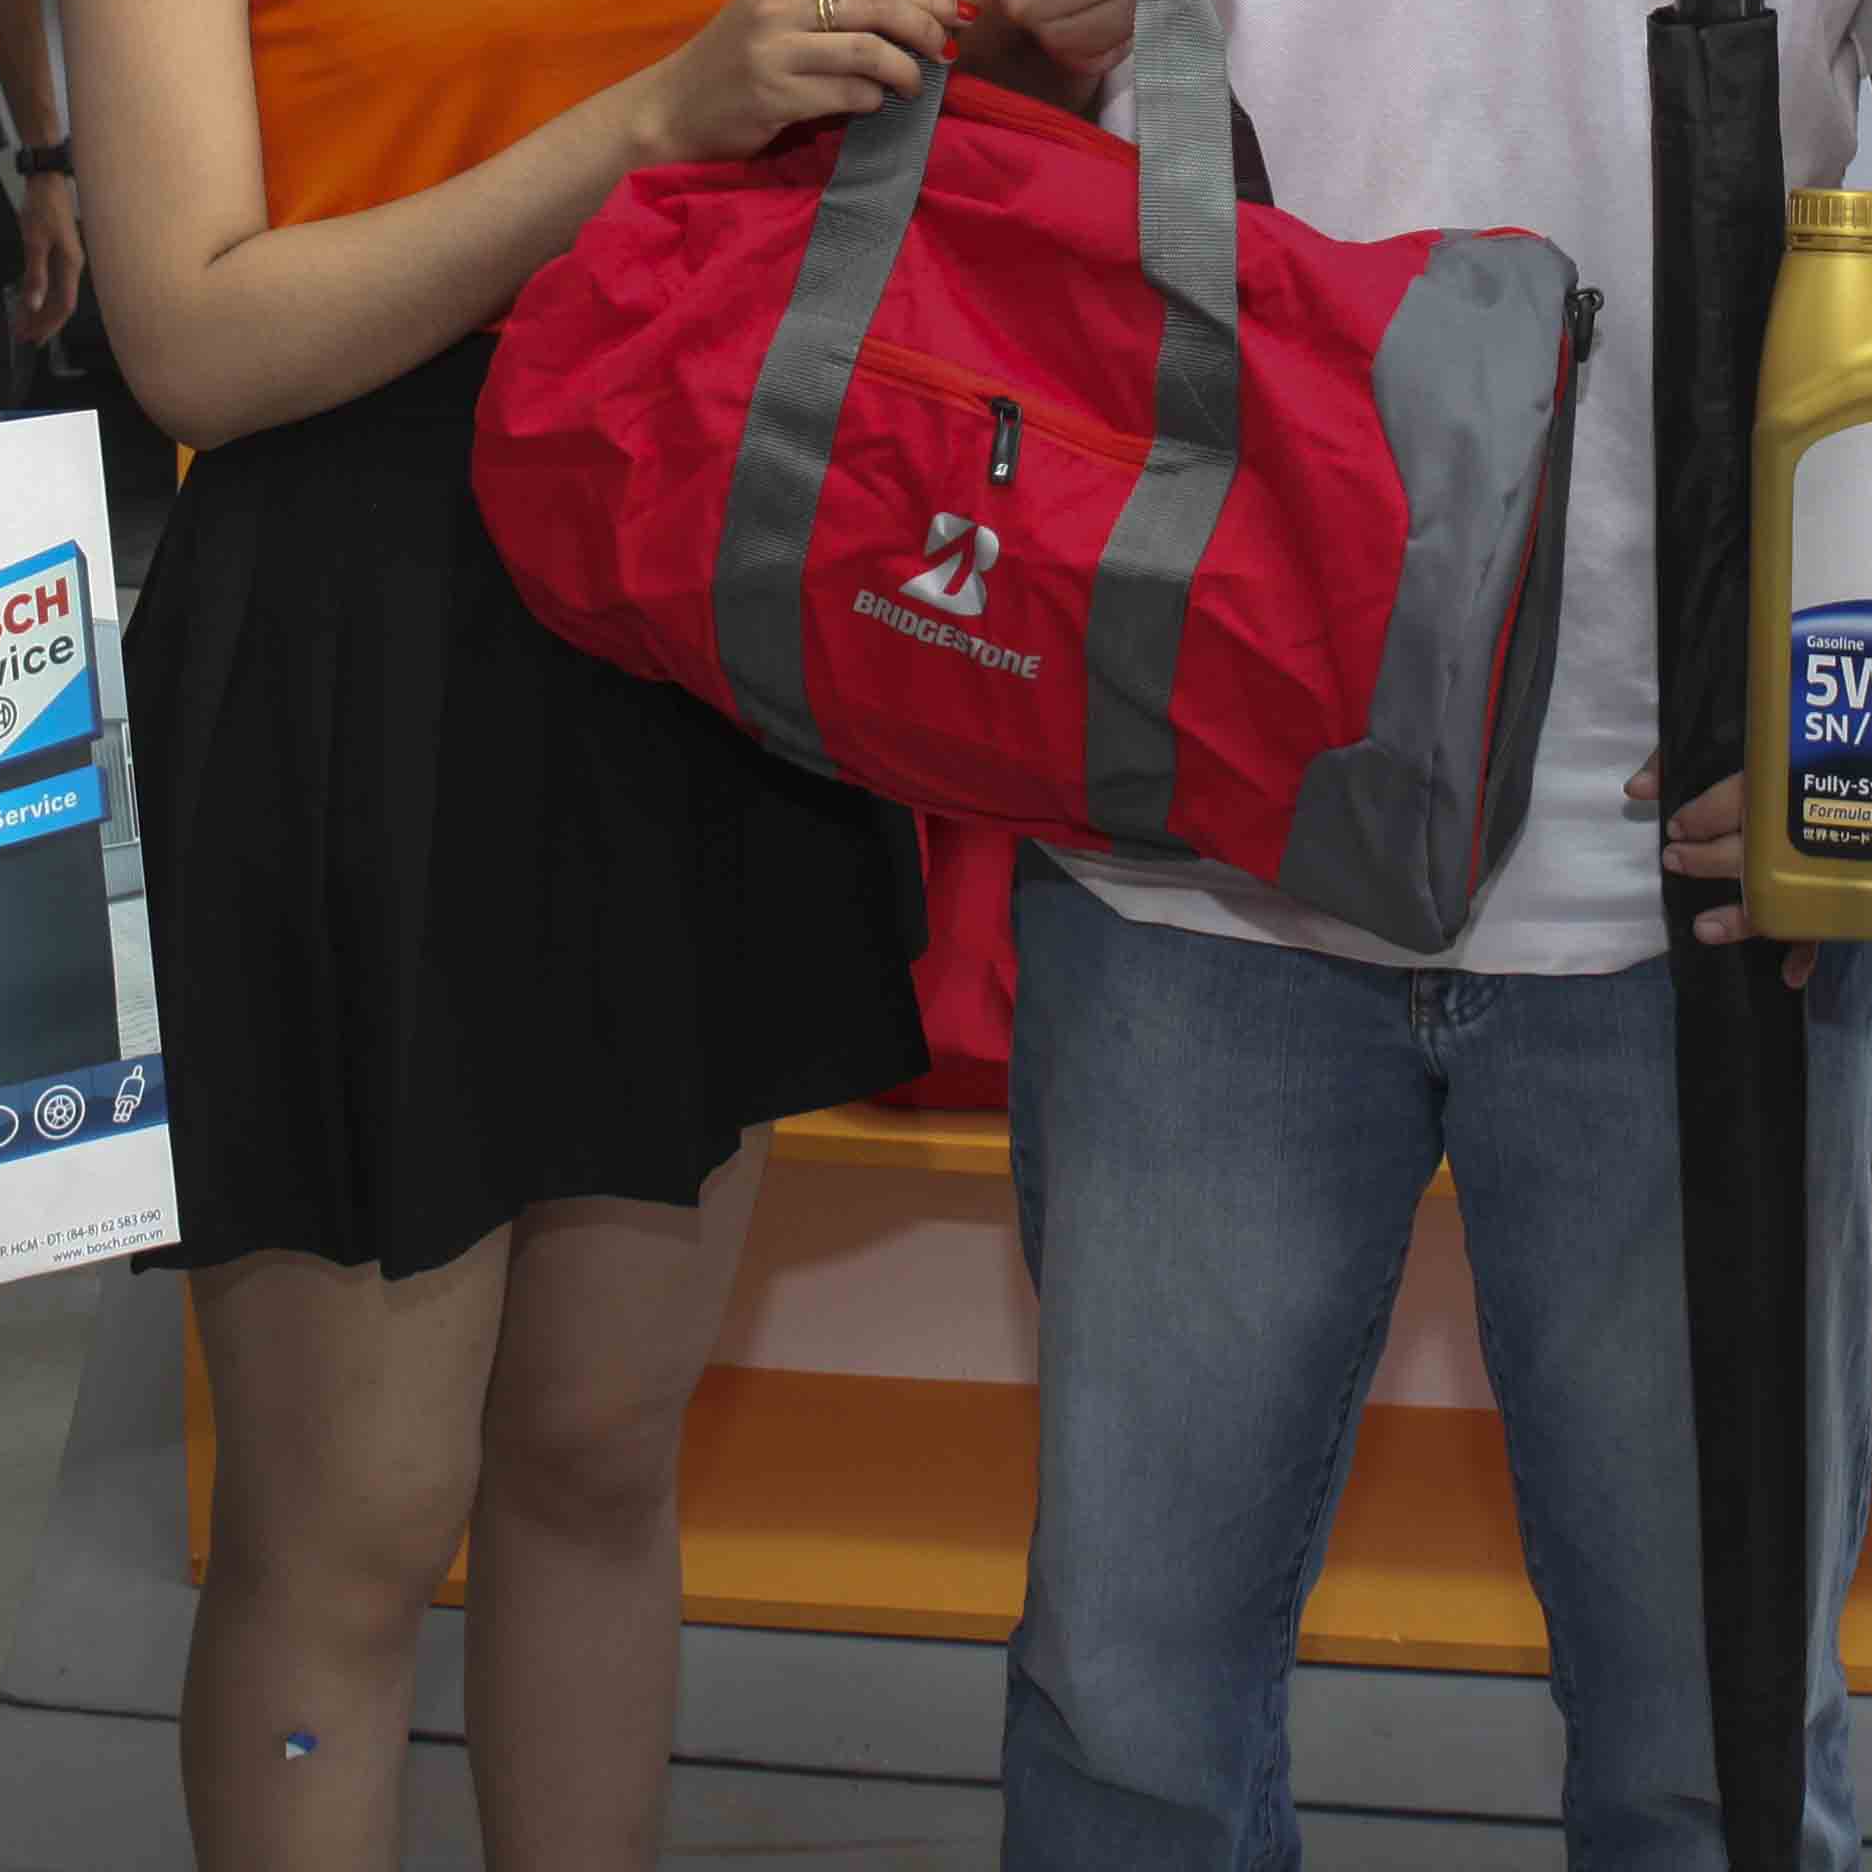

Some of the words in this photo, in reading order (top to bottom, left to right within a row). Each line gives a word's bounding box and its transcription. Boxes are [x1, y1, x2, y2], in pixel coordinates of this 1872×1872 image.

[852, 589, 1042, 679] BRIDGESTONE
[1807, 635, 1864, 651] Gasoline
[11, 1239, 38, 1256] HCM
[141, 1208, 161, 1223] 690
